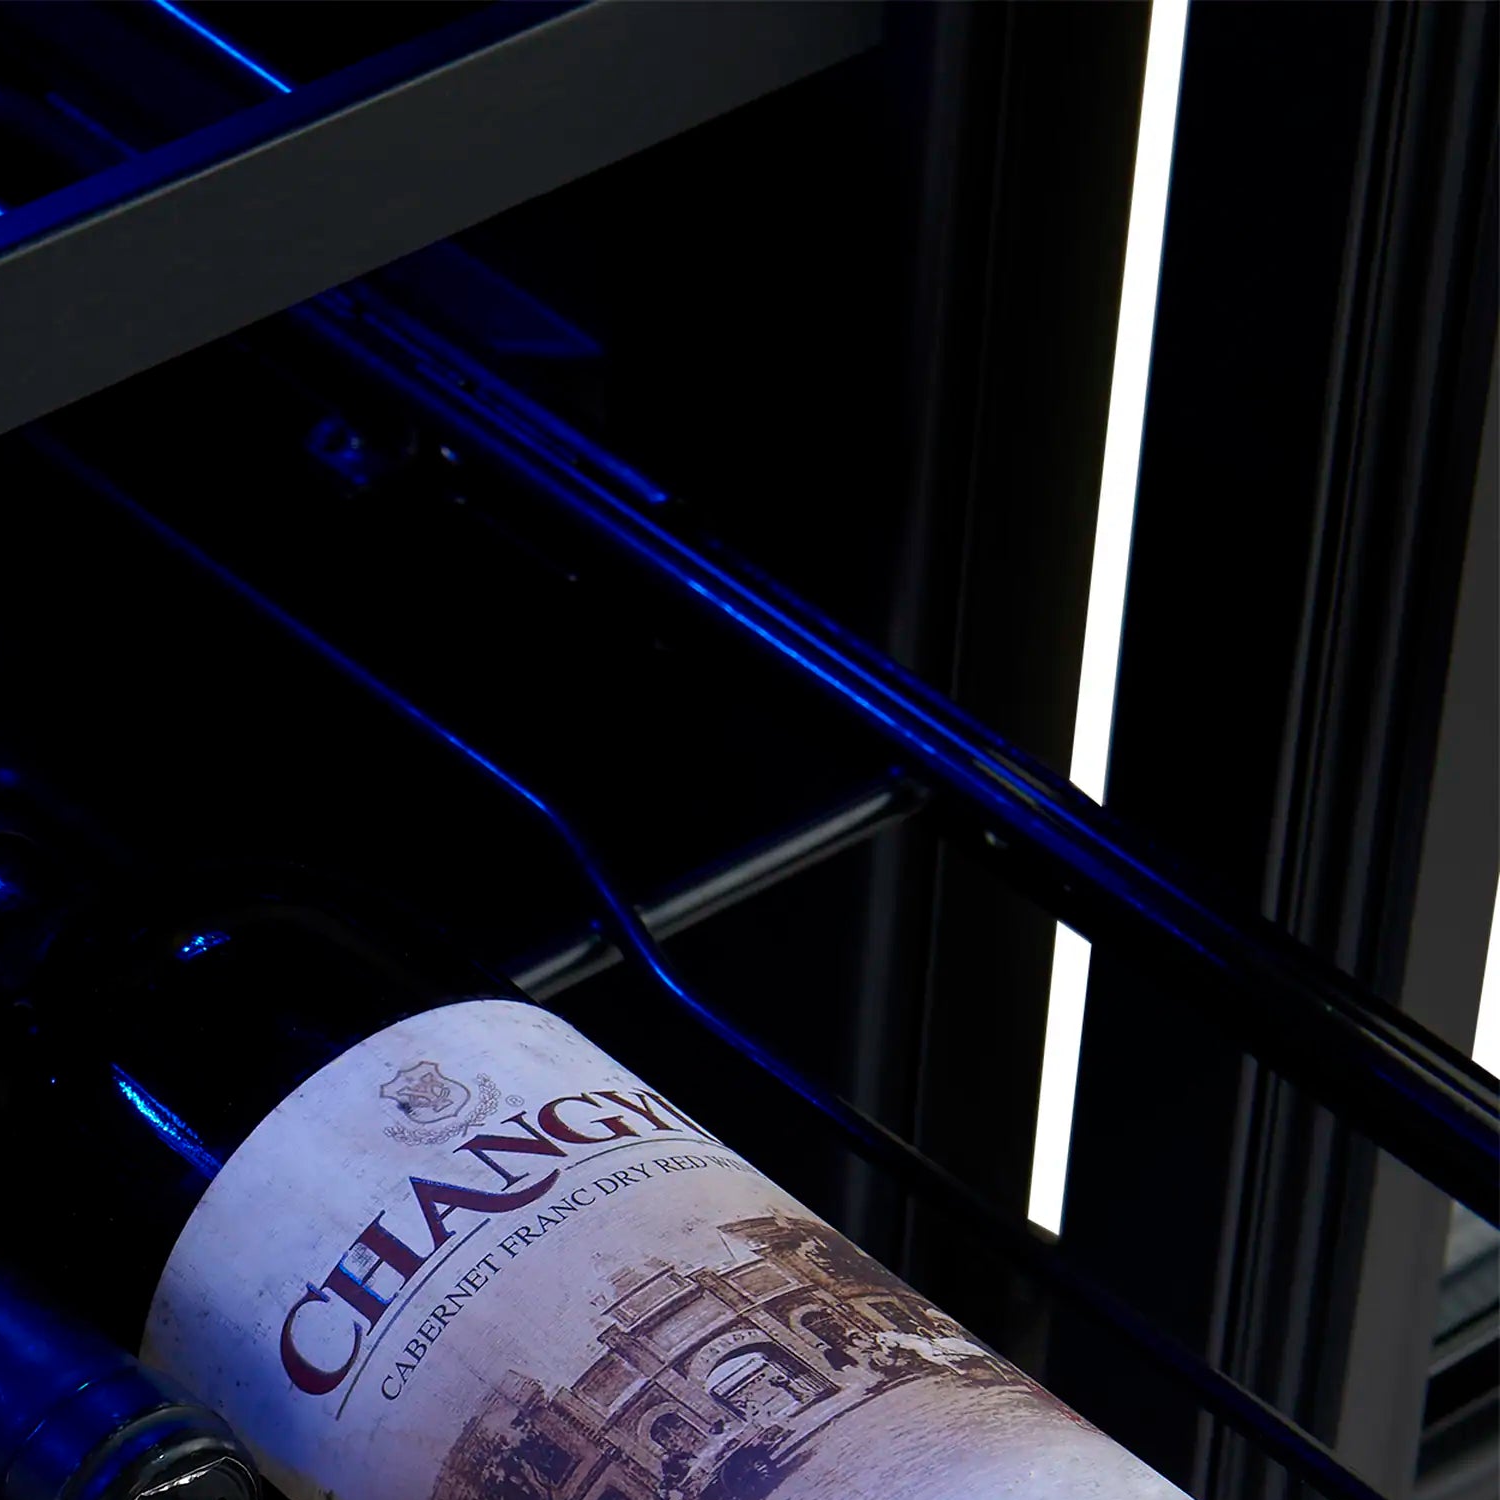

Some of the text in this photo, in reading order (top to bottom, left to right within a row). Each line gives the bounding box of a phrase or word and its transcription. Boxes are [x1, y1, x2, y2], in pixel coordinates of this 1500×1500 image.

[381, 1252, 501, 1400] CABERNET
[498, 1188, 596, 1258] FRANC
[593, 1163, 653, 1196] DRY
[653, 1154, 708, 1173] RED
